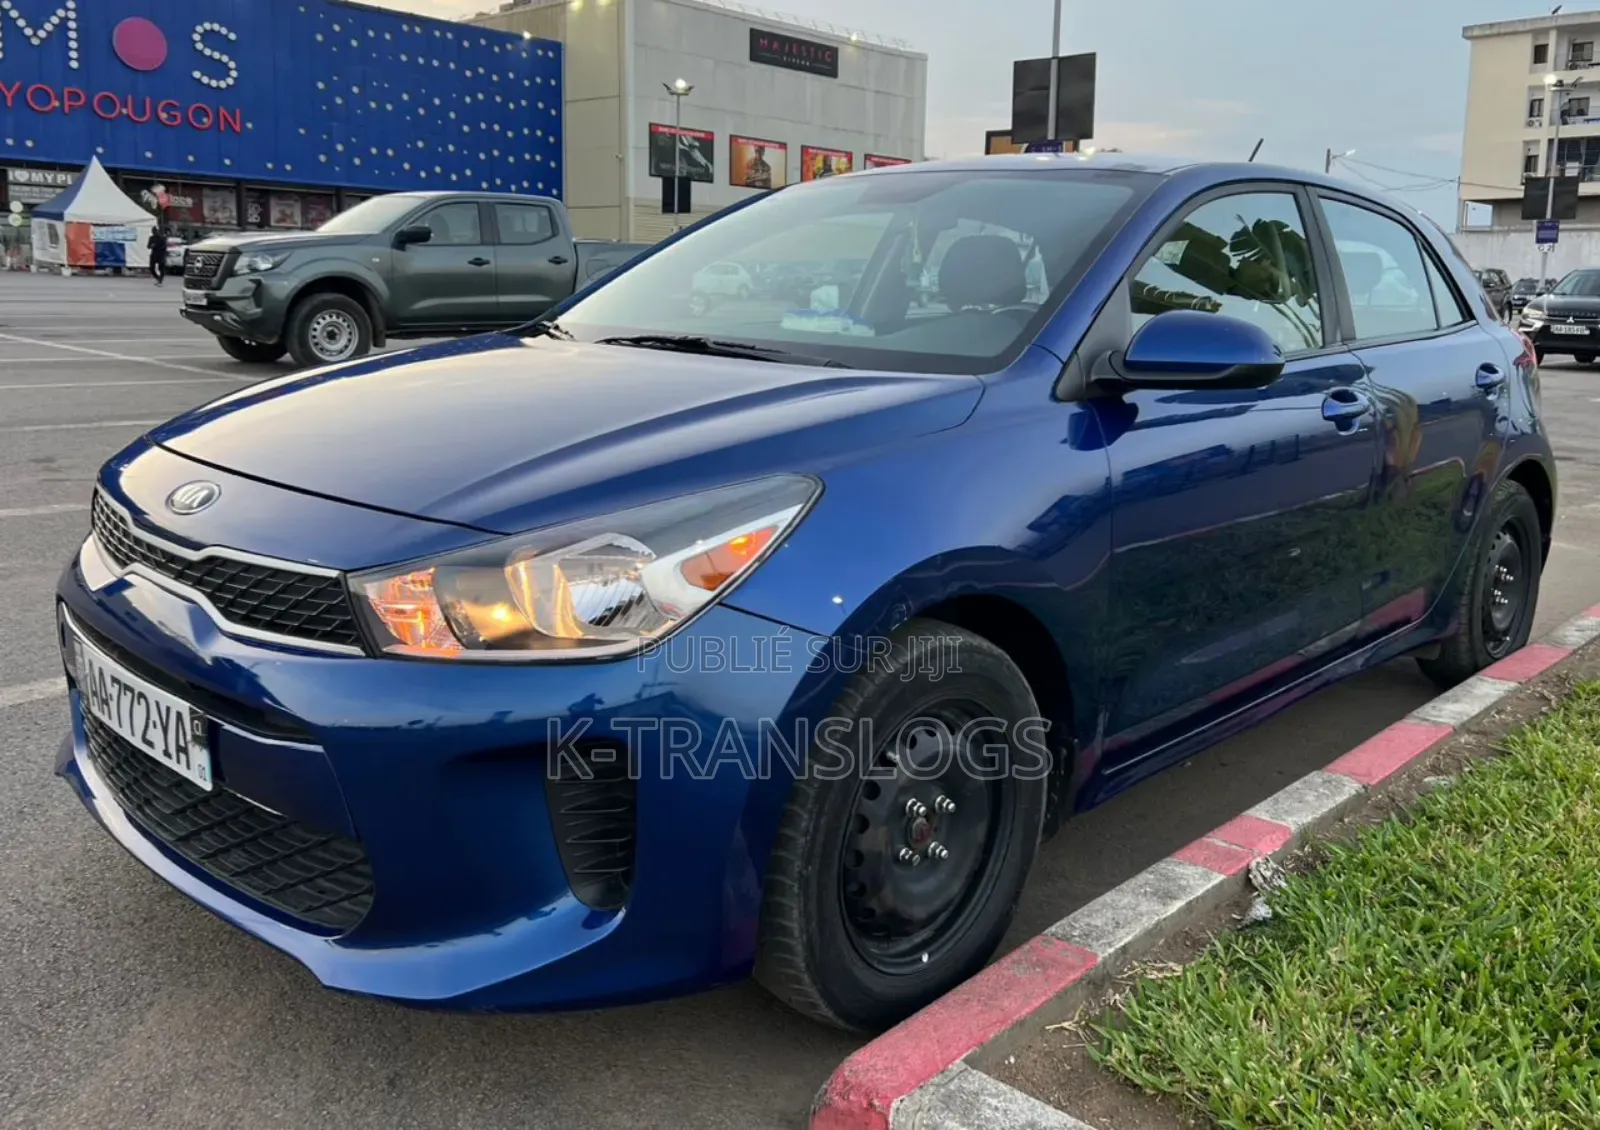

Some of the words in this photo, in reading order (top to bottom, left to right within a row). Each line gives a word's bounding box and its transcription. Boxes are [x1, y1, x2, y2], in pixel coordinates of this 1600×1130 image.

[759, 37, 832, 62] MAJESTIC
[0, 81, 241, 134] YOPOUGON
[88, 658, 191, 771] AA-772-YA
